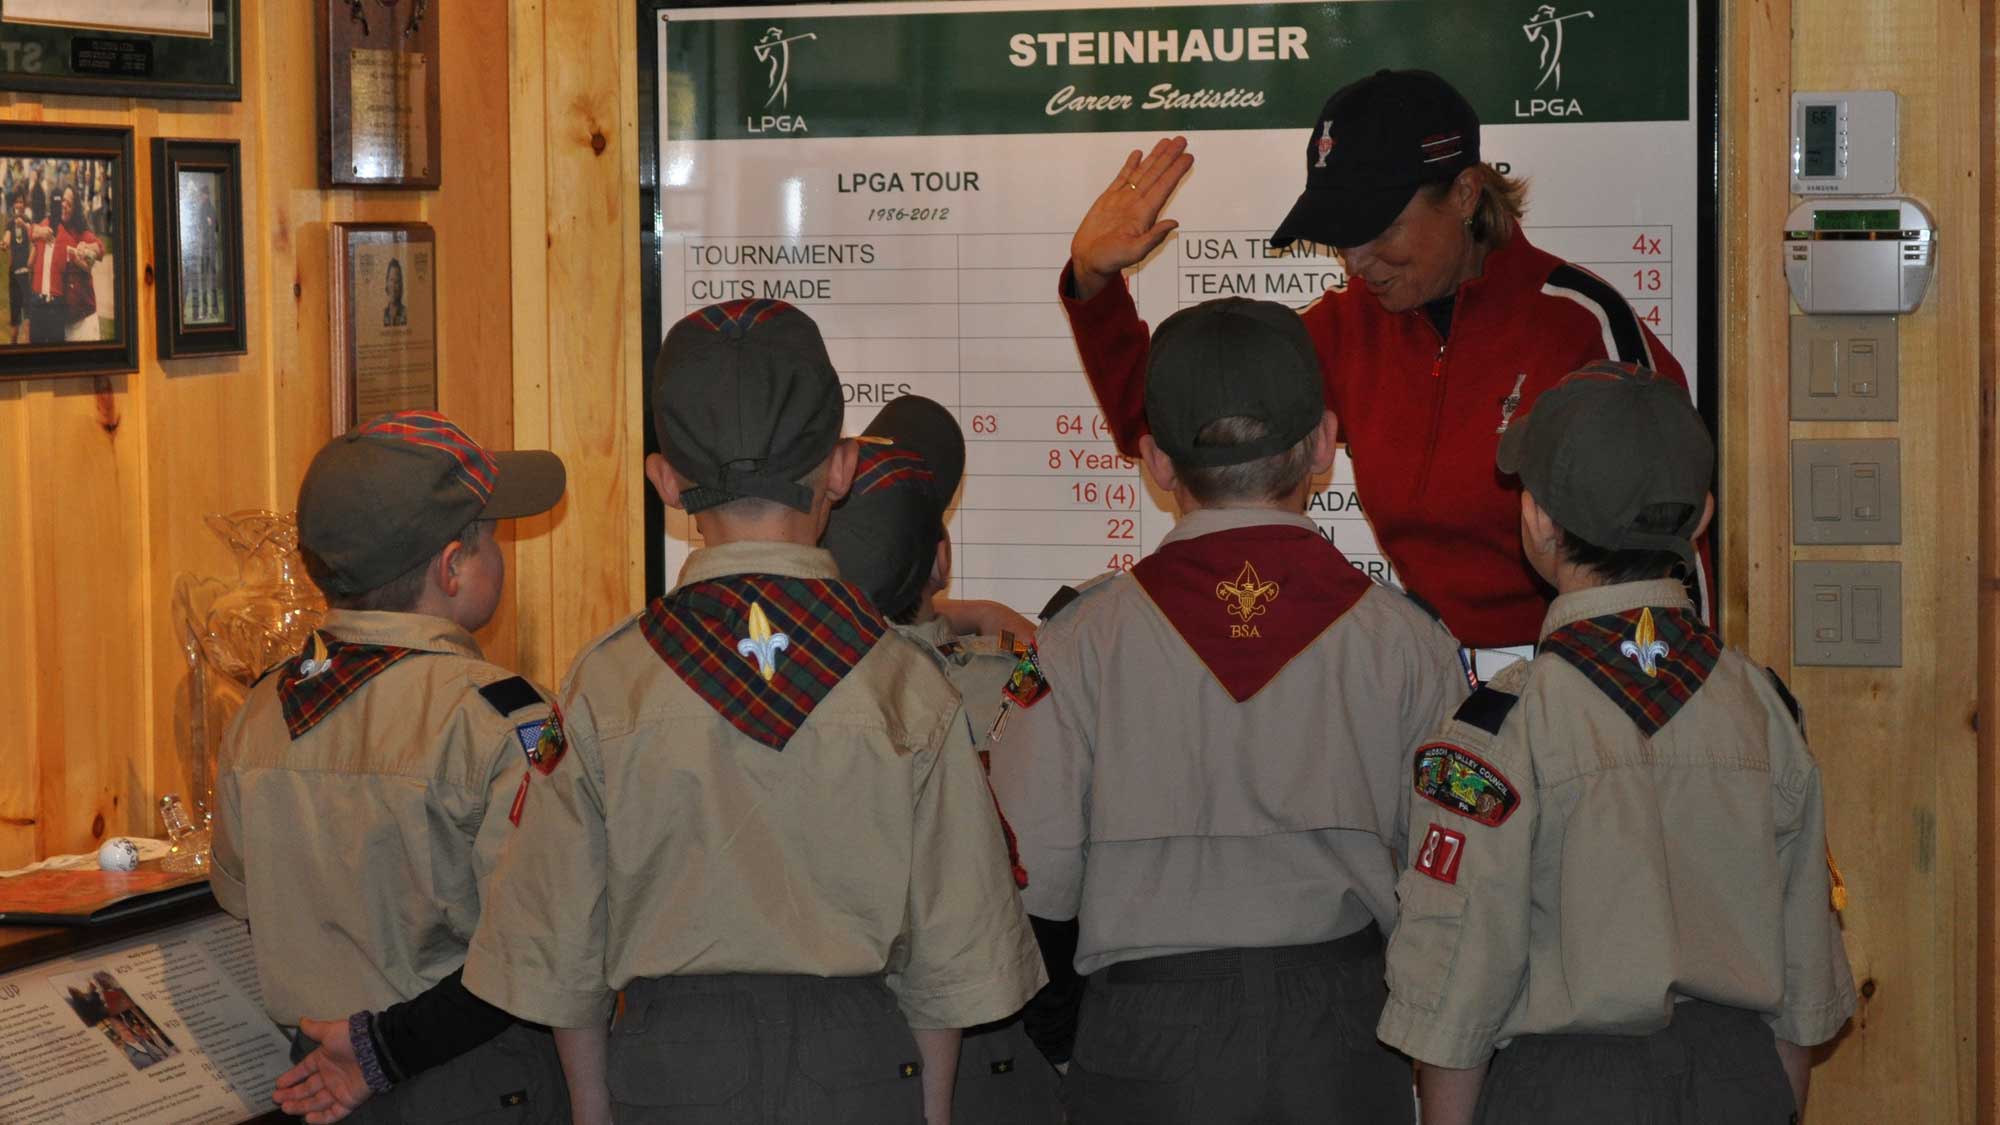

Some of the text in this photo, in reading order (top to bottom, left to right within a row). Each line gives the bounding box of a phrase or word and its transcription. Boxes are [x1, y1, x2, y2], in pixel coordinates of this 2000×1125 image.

[1008, 26, 1310, 67] STEINHAUER
[1045, 83, 1266, 116] Career Statistics
[1514, 98, 1584, 118] LPGA
[747, 114, 809, 134] LPGA
[837, 171, 980, 193] LPGA TOUR
[867, 207, 950, 222] 1986-2012
[690, 244, 875, 265] TOURNAMENTS
[1185, 238, 1239, 260] USA
[1245, 238, 1317, 259] TEAM
[1631, 233, 1662, 256] 4x
[691, 279, 831, 300] CUTS MADE
[1184, 273, 1256, 294] TEAM
[1633, 269, 1662, 291] 13
[840, 383, 912, 403] ORIES
[972, 415, 998, 434] 63
[1056, 414, 1112, 440] 64 (4
[1048, 449, 1135, 470] 8 Years
[1072, 482, 1136, 510] 16 (4)
[1305, 491, 1363, 512] ADA
[1107, 519, 1135, 539] 22
[1107, 553, 1135, 573] 48
[1230, 624, 1263, 639] BSA
[1454, 751, 1479, 769] VALLEY
[1479, 767, 1508, 796] COUNCIL
[1422, 830, 1460, 876] 87
